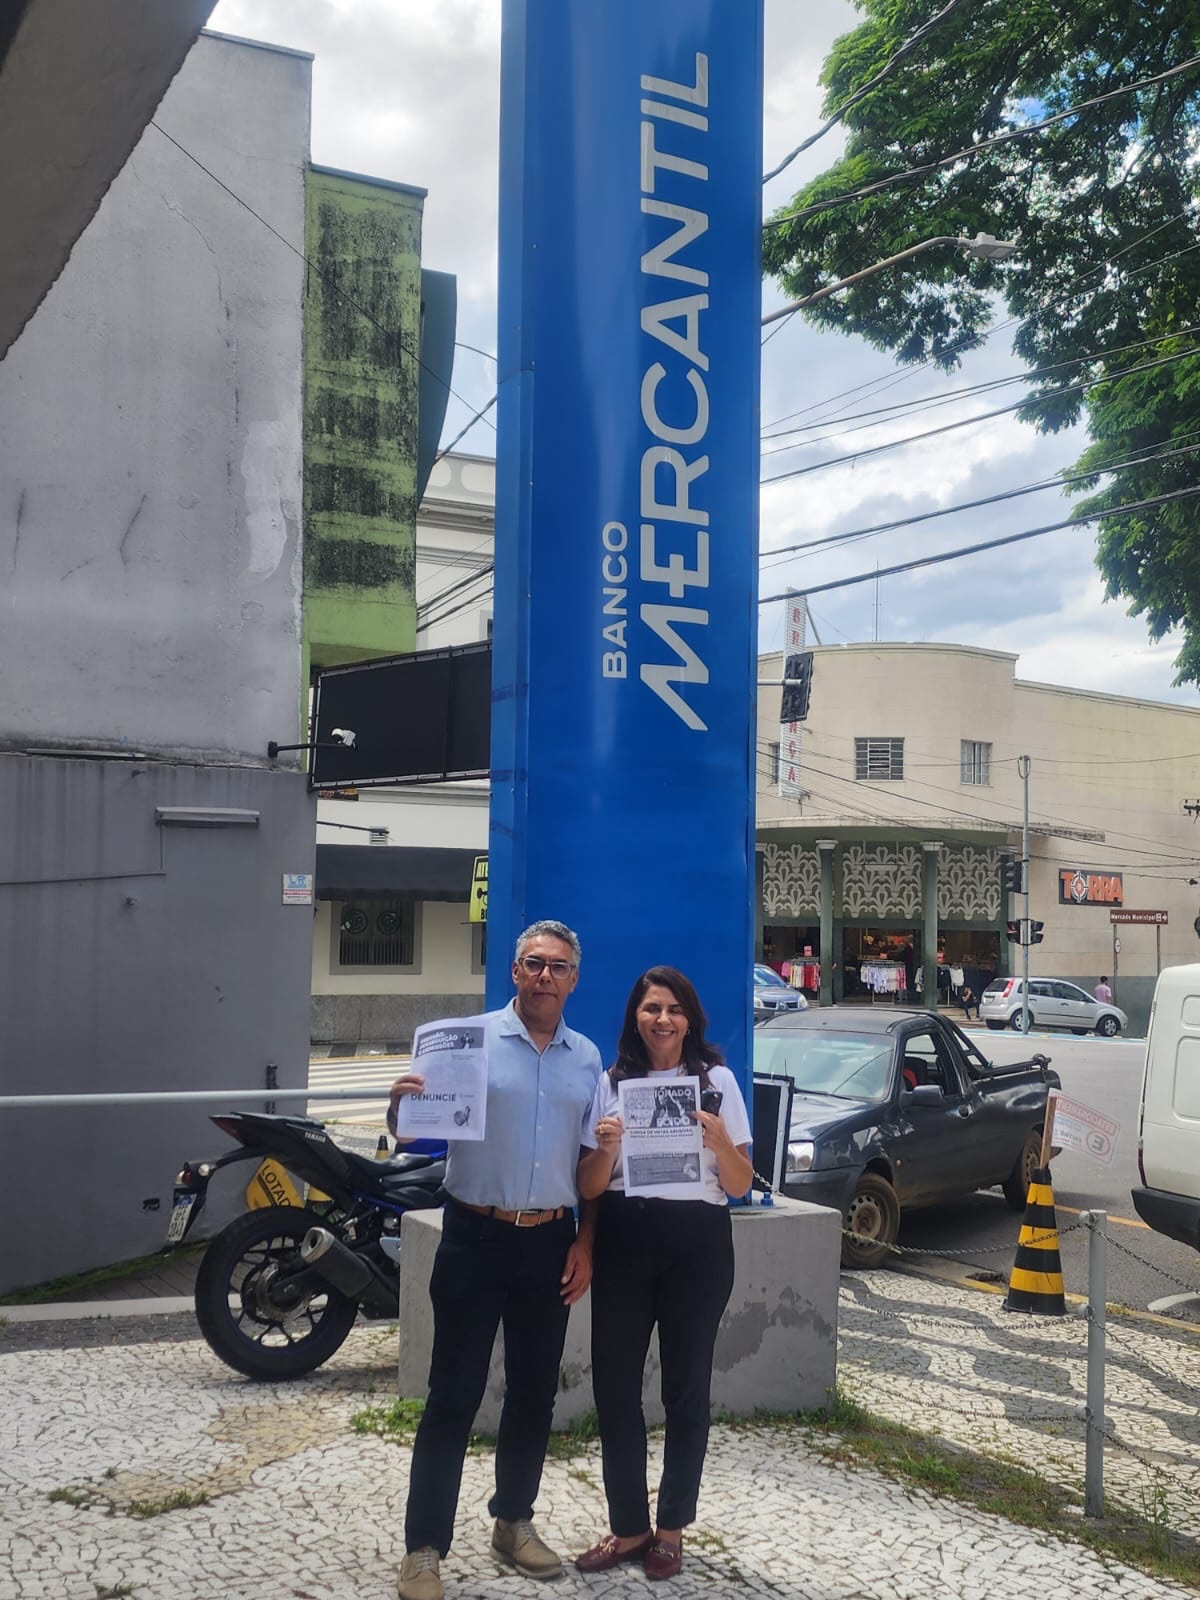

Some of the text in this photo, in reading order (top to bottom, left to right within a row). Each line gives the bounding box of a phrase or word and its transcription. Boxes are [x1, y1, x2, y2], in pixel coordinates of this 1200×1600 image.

[640, 52, 709, 731] MERCANTIL
[602, 521, 628, 679] BANCO
[788, 607, 801, 782] BRNÇA
[1061, 870, 1123, 902] TORRA
[411, 1093, 456, 1102] DENUNCIE
[304, 1131, 326, 1143] YAMAHA
[262, 1164, 292, 1207] LOTAD
